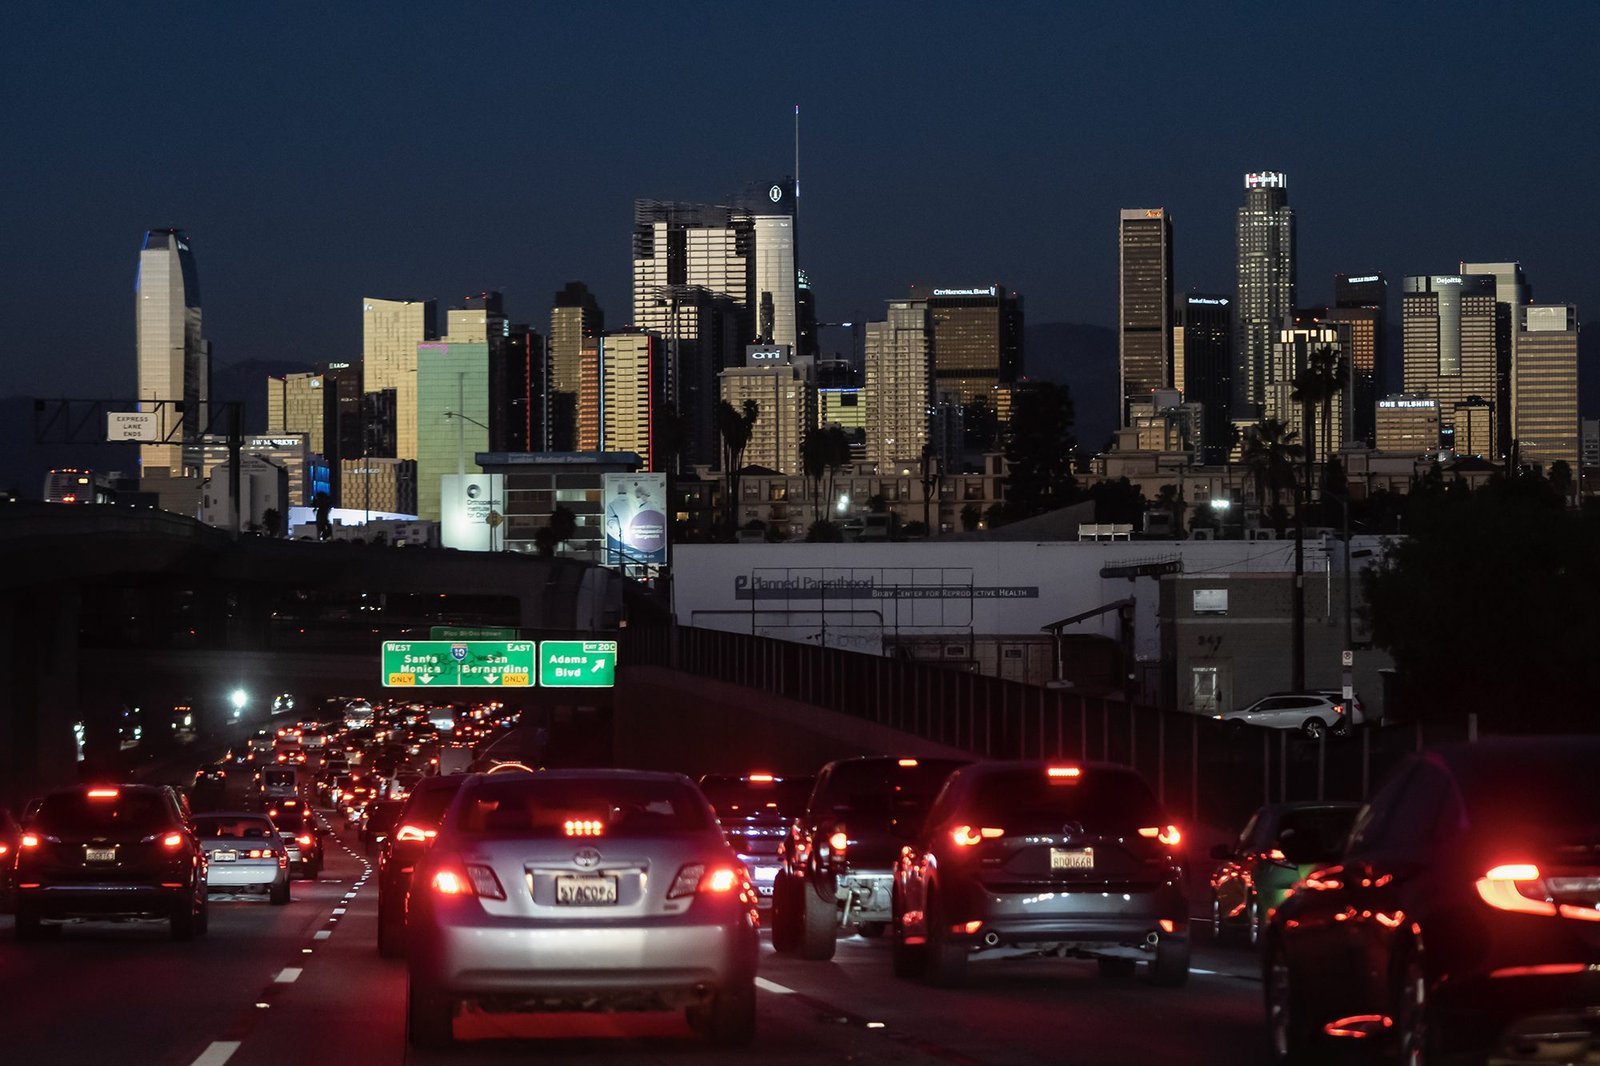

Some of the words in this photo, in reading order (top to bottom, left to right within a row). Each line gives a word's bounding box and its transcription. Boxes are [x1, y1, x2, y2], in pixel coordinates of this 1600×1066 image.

[752, 576, 800, 589] Planned
[803, 575, 874, 589] Parenthood
[387, 643, 411, 652] WEST
[507, 643, 531, 652] EAST
[598, 643, 616, 651] 20C
[454, 648, 465, 657] 10
[405, 654, 438, 663] Santa
[486, 655, 508, 663] San
[549, 654, 588, 664] Adams
[400, 664, 442, 673] Monica
[462, 664, 529, 673] Bernardino
[555, 667, 581, 677] Blvd
[390, 675, 413, 683] ONLY
[504, 675, 527, 683] ONLY
